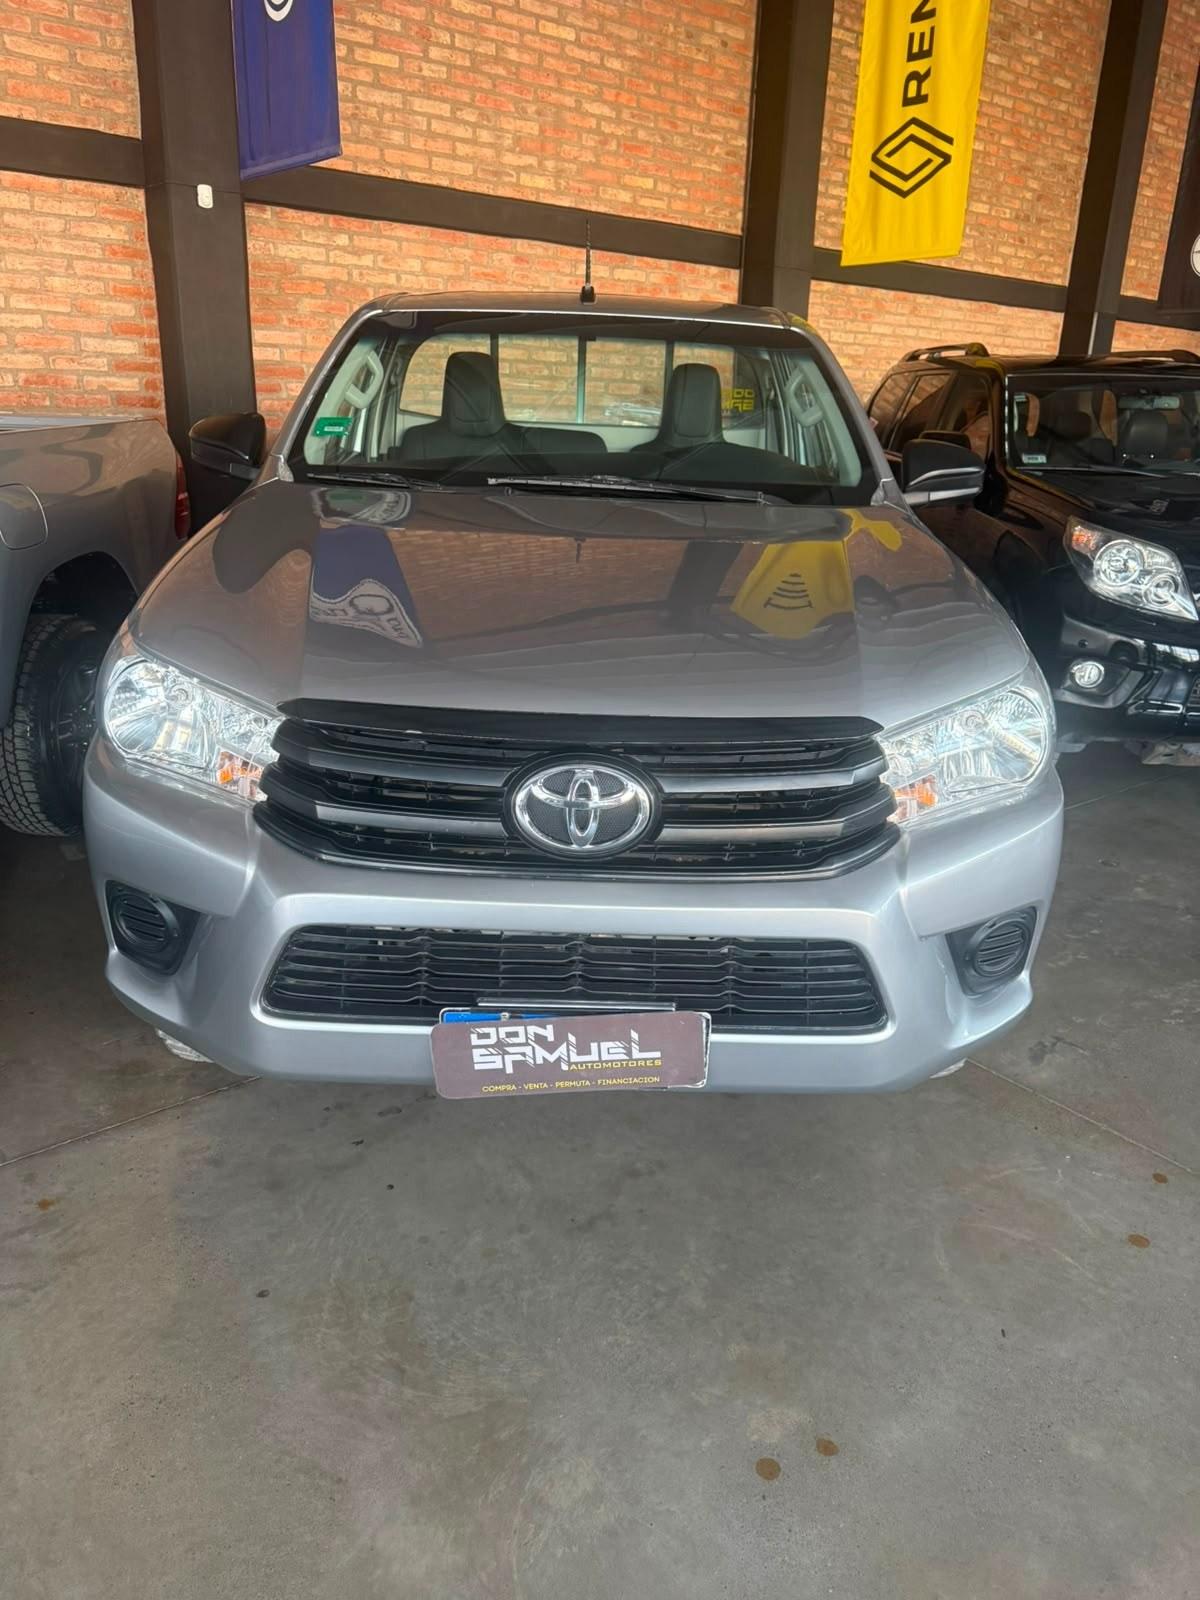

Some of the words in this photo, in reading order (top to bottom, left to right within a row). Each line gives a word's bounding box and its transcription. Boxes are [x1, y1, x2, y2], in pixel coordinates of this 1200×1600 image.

[470, 1024, 555, 1046] DON
[471, 1029, 662, 1074] SAMUEL
[569, 1059, 663, 1072] AUTOMOTORES
[482, 1084, 517, 1093] COMPRA
[523, 1081, 549, 1090] VENTA
[555, 1079, 591, 1089] PERMUTA
[597, 1075, 661, 1087] FINANCIACION
